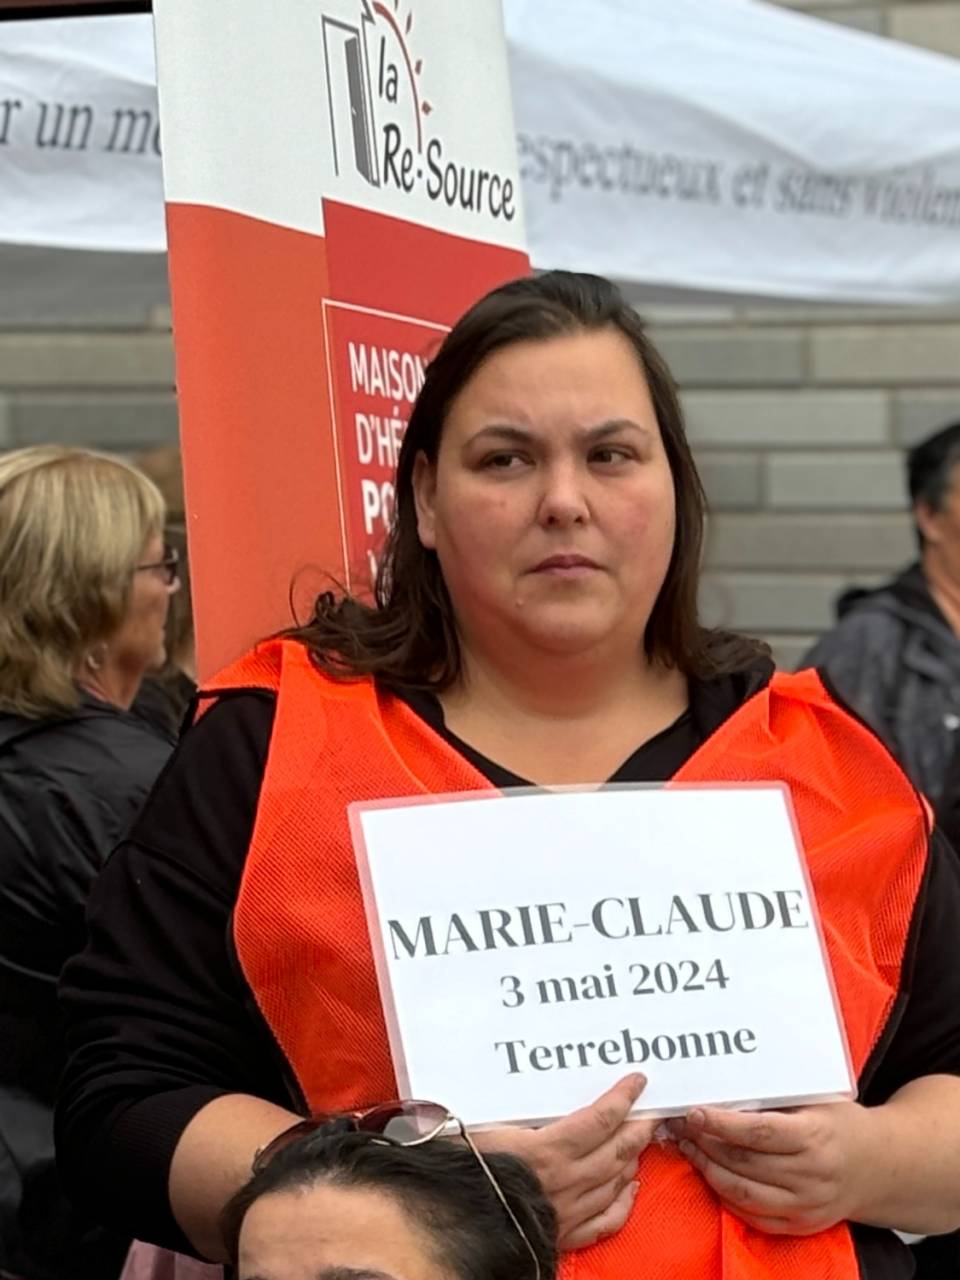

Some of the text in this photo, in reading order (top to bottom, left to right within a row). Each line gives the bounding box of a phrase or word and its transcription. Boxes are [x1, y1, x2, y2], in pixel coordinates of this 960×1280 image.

[378, 35, 399, 104] la
[36, 101, 94, 150] un
[387, 888, 810, 961] MARIE-CLAUDE
[500, 958, 731, 1009] 3 mai 2024
[494, 1027, 758, 1075] Terrebonne
